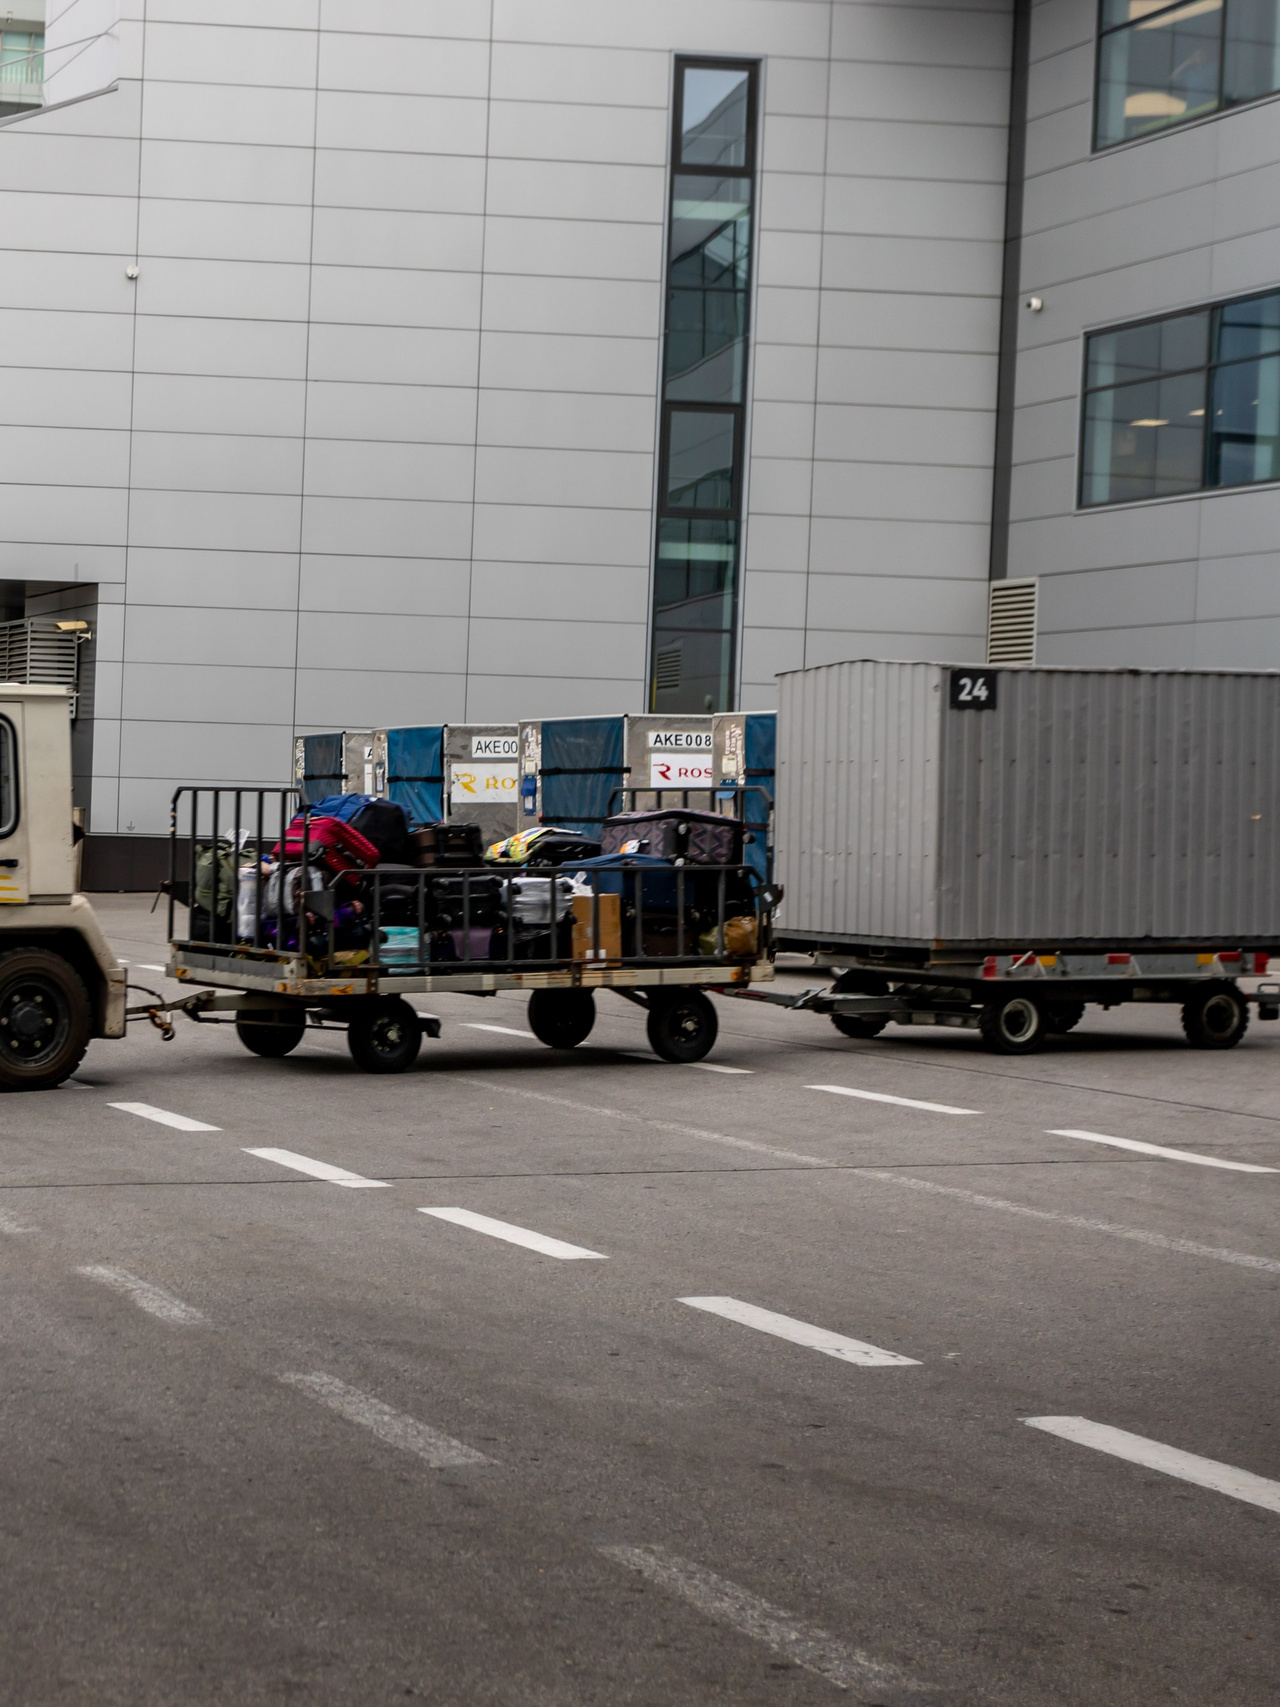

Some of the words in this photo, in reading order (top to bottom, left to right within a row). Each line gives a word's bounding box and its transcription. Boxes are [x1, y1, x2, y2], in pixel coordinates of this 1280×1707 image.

[958, 677, 989, 701] 24
[474, 740, 518, 754] AKE00
[653, 733, 712, 747] AKE008
[678, 767, 713, 779] ROS
